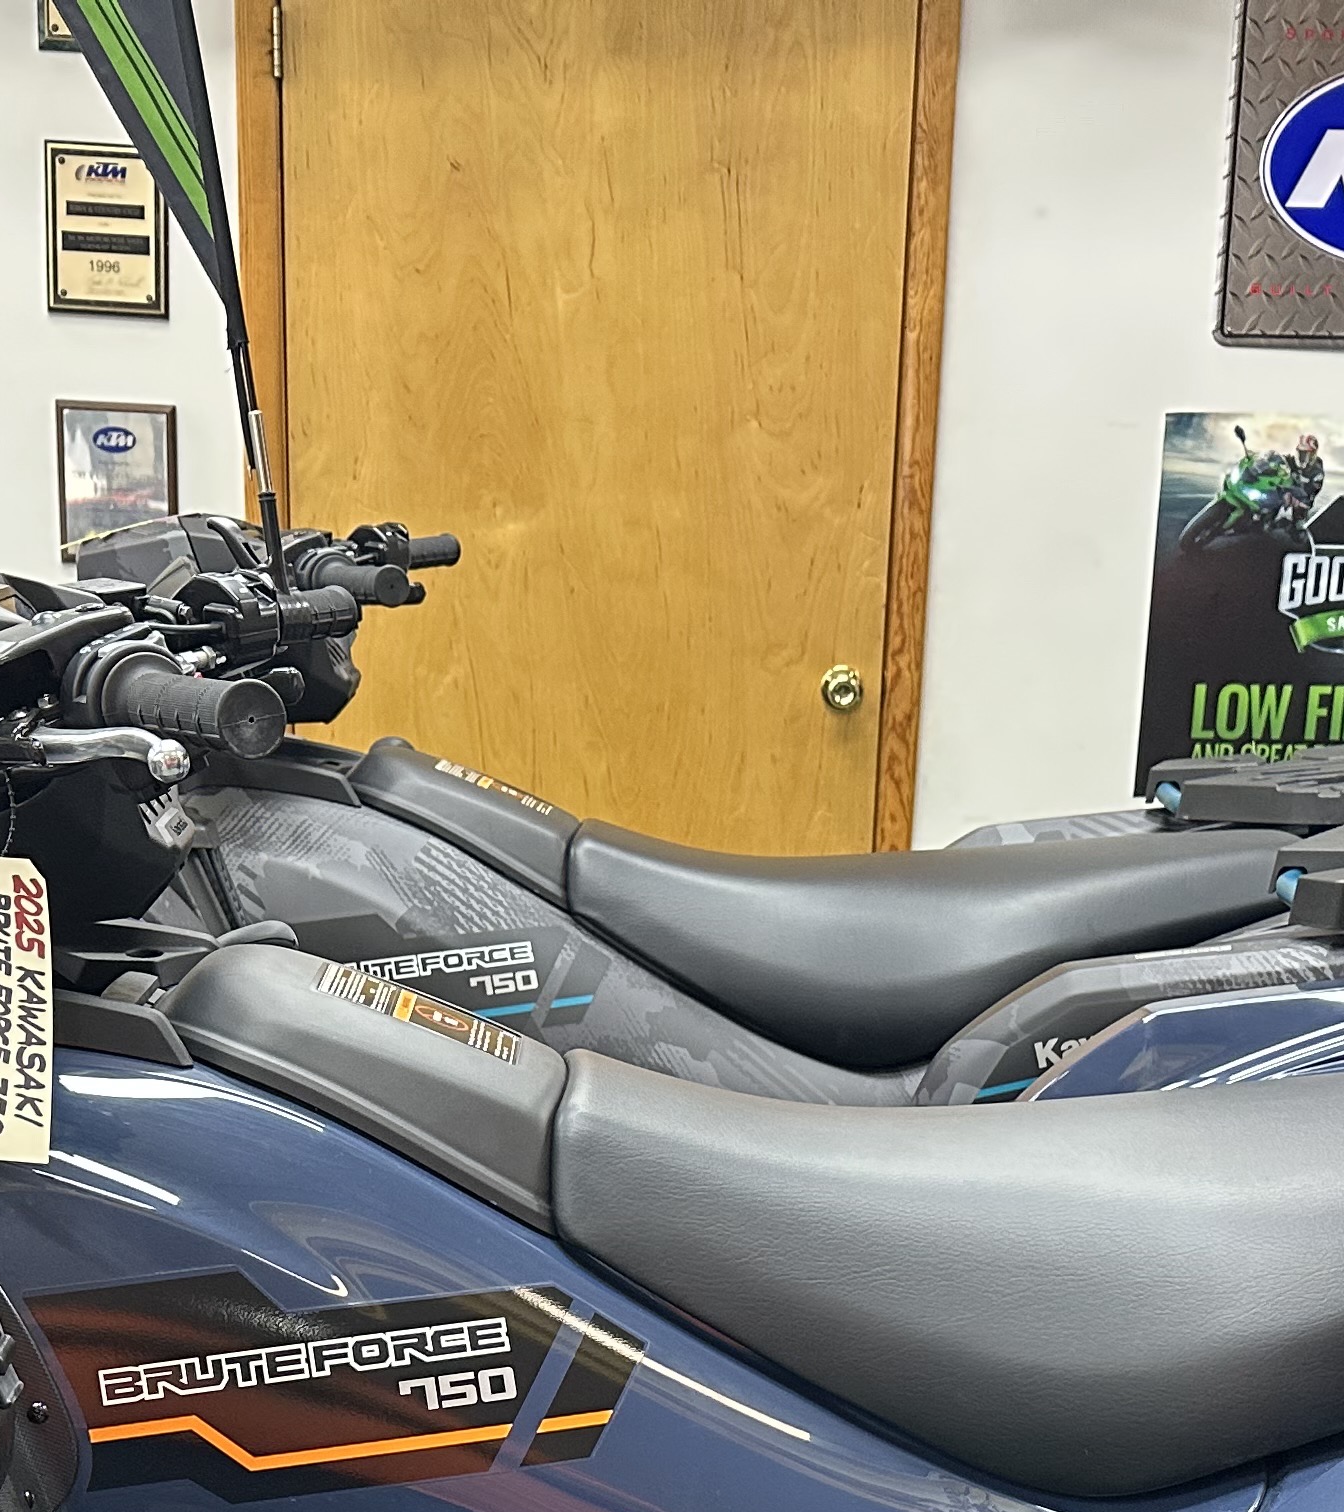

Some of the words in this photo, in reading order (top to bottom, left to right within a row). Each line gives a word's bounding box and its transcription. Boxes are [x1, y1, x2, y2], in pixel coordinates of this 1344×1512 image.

[86, 161, 128, 179] KTM
[89, 259, 121, 274] 1996
[96, 431, 134, 447] KTM
[1191, 683, 1293, 741] LOW
[1191, 742, 1234, 760] AND
[12, 874, 46, 960] 2025
[469, 968, 540, 996] 750
[14, 965, 48, 1128] KAWASAKI
[398, 1366, 517, 1411] 750
